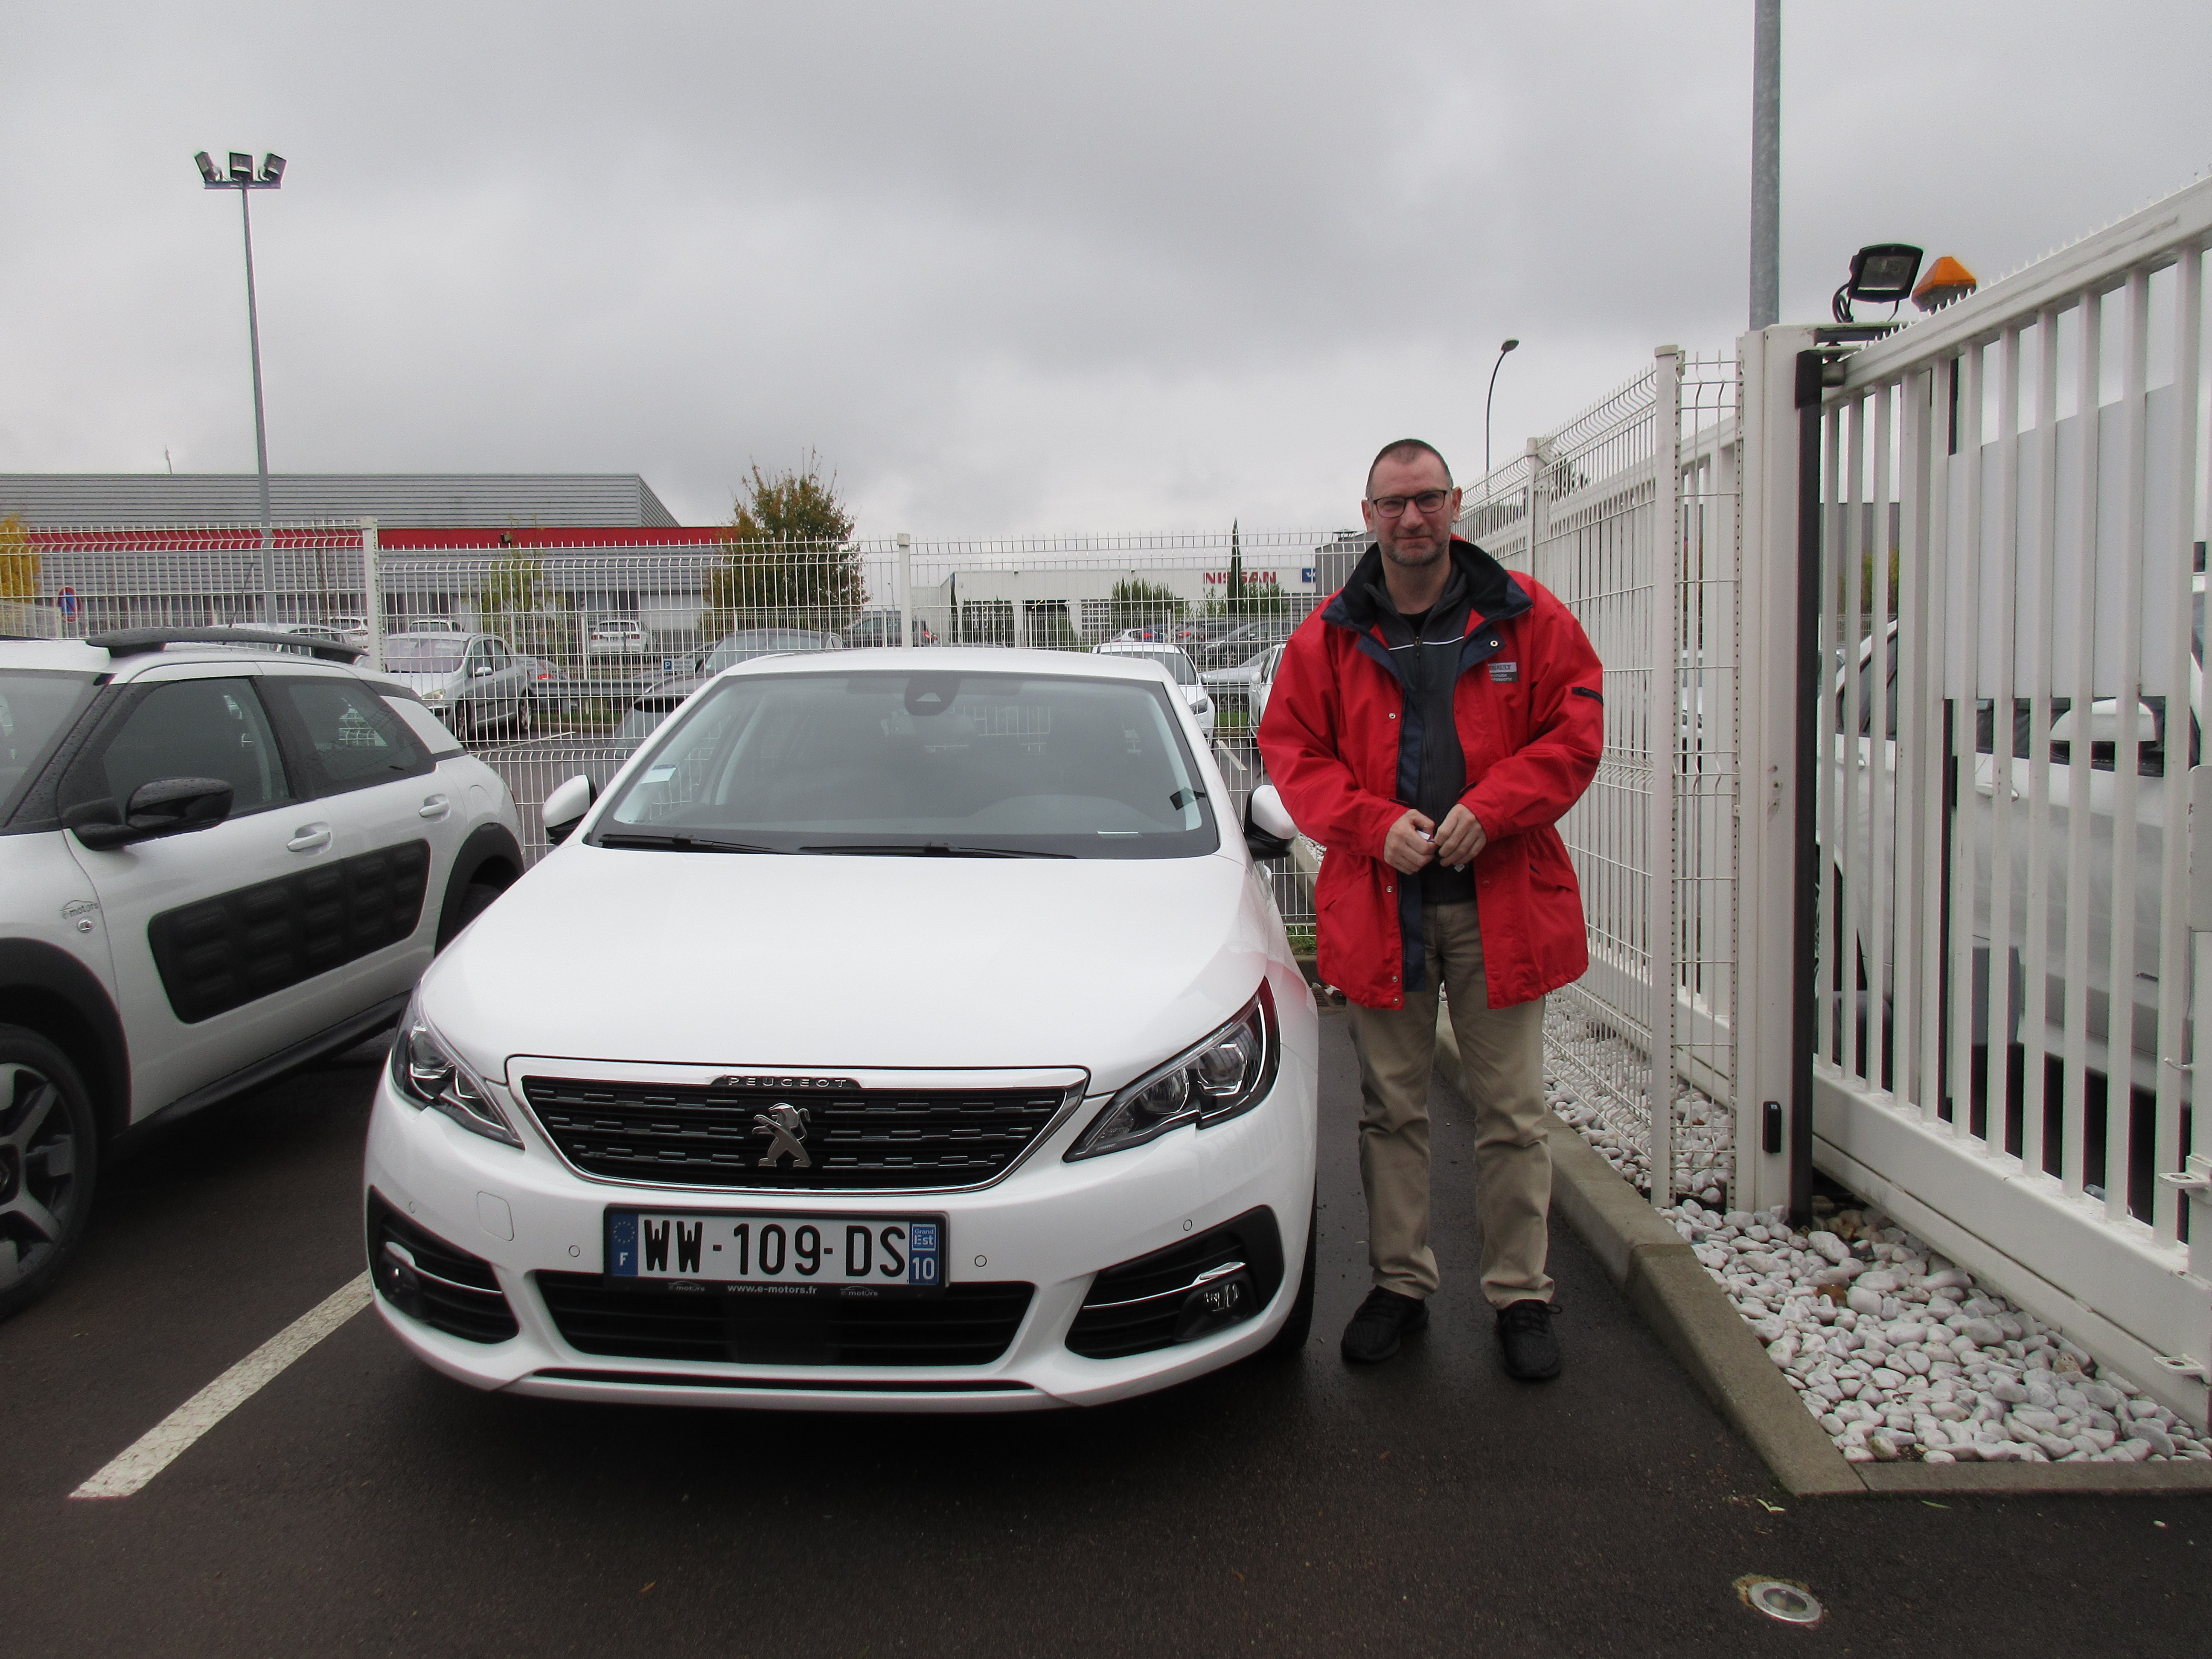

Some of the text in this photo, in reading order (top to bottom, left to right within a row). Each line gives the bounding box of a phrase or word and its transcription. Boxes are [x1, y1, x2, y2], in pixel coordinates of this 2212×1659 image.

[728, 1077, 847, 1088] PEUGEOT
[914, 1234, 934, 1245] Est
[619, 1252, 629, 1266] F
[912, 1257, 935, 1280] 10
[728, 1285, 818, 1294] www.e-motors.fr
